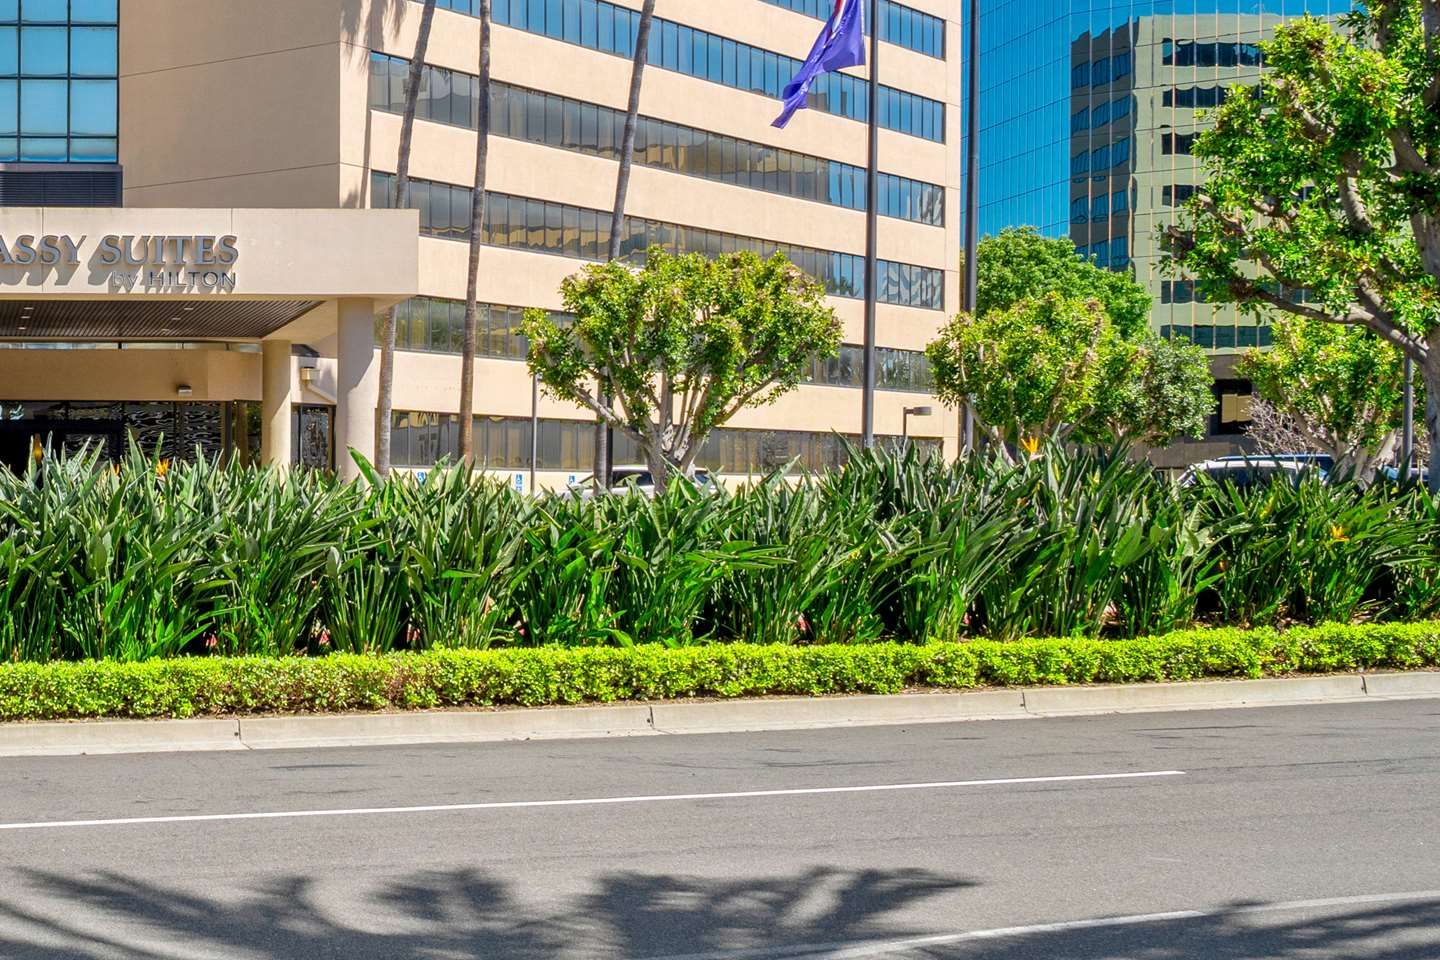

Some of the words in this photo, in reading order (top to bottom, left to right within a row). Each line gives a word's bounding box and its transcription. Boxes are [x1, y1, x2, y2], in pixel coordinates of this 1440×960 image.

[99, 234, 239, 266] SUITES
[112, 271, 140, 291] by
[149, 271, 237, 288] HILTON
